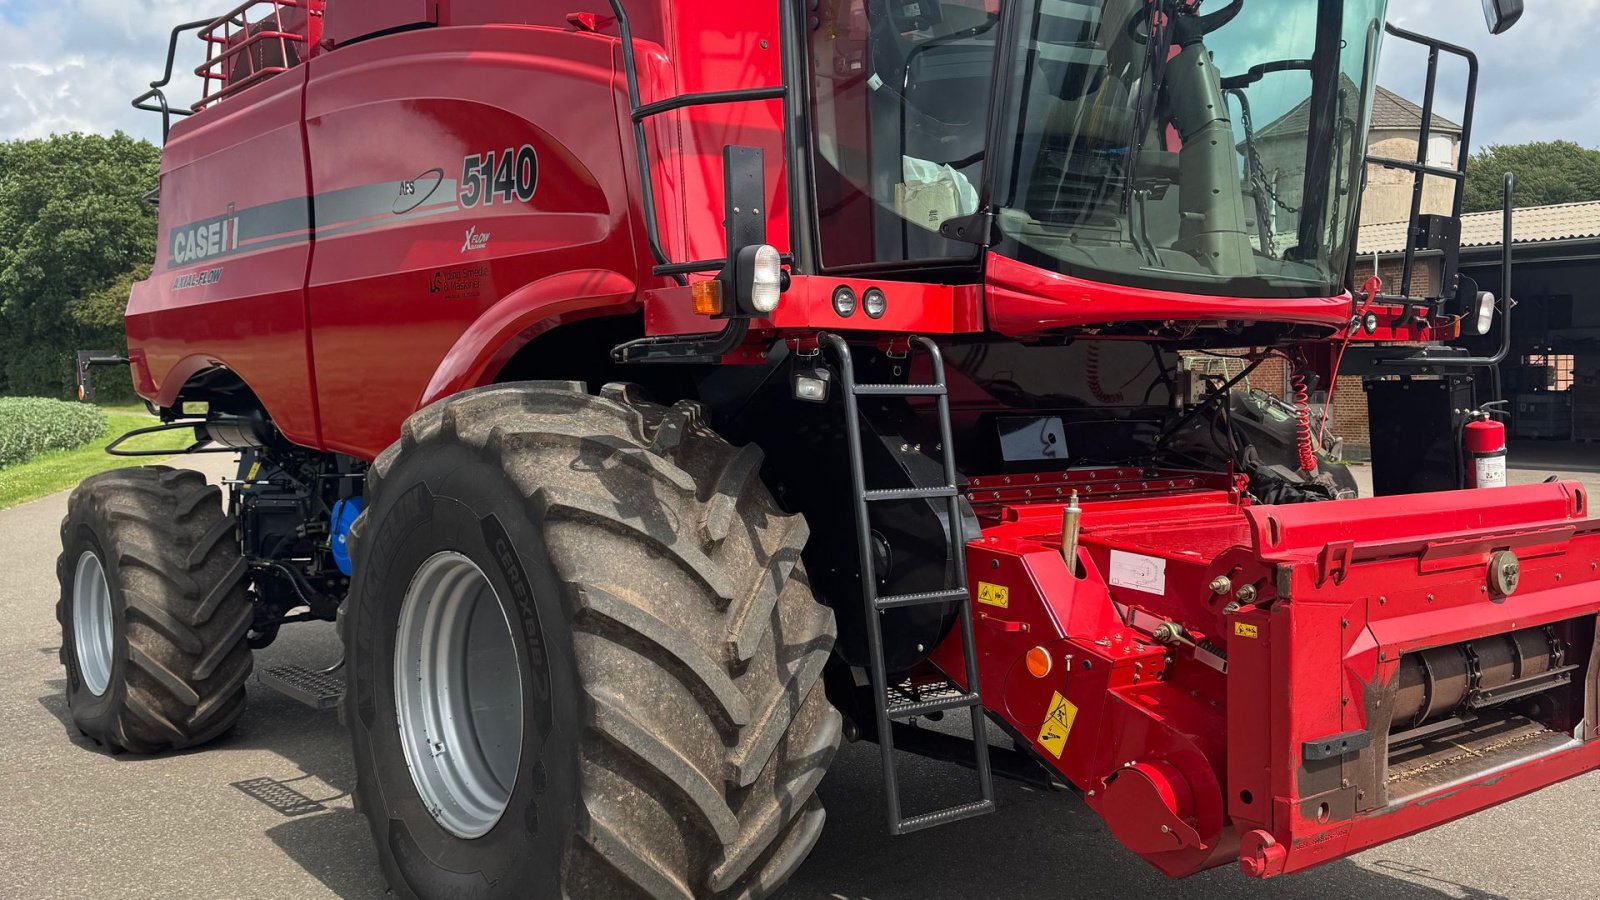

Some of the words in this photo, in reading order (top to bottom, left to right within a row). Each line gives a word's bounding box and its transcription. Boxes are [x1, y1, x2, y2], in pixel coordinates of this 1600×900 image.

[399, 180, 416, 196] AFS
[460, 144, 538, 208] 5140
[171, 267, 223, 291] AXIAL-FLOW
